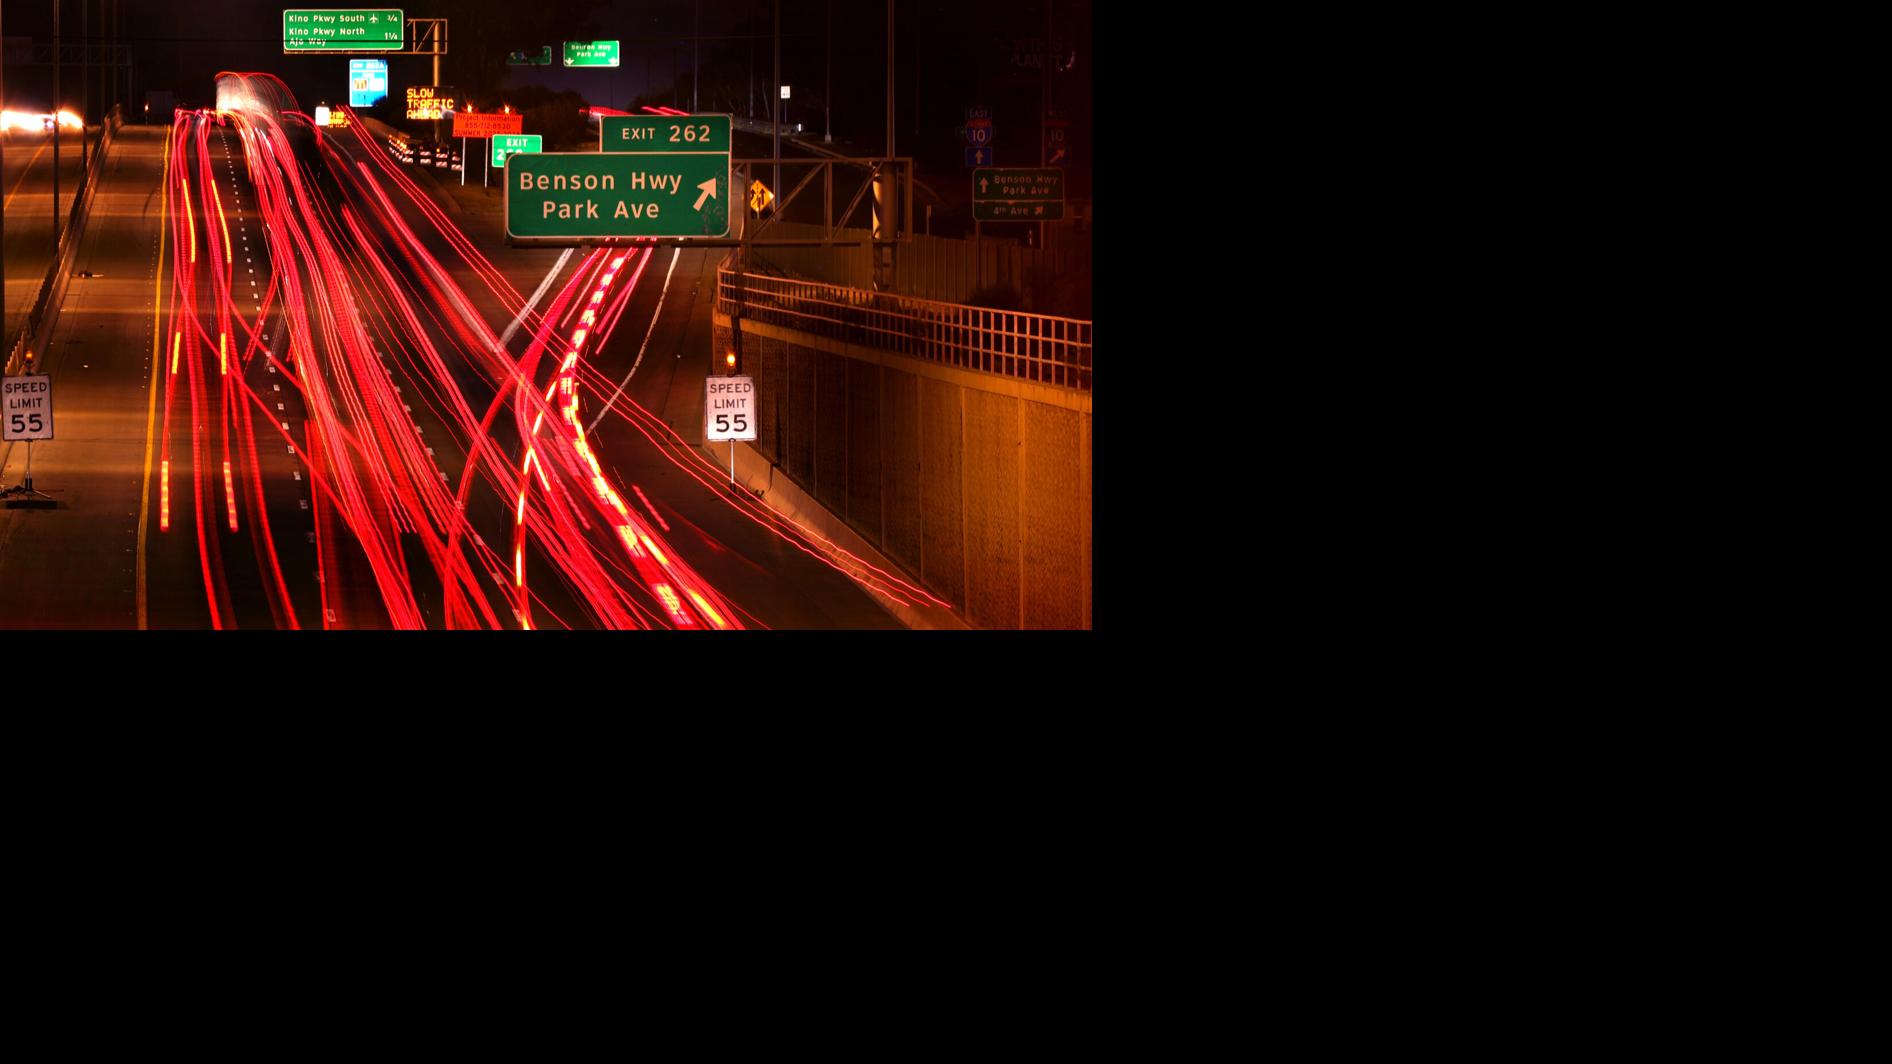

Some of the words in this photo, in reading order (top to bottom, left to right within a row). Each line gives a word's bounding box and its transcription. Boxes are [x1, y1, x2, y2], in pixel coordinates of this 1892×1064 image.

[313, 15, 335, 23] Pkwy
[313, 28, 335, 36] Pkwy
[289, 38, 304, 46] Ajo
[308, 38, 326, 46] Way
[407, 88, 434, 98] SLOW
[407, 99, 454, 109] TRAFFIC
[407, 109, 441, 119] AHEAD
[622, 127, 656, 140] EXIT
[669, 125, 710, 142] 262
[972, 129, 986, 142] 10
[1051, 129, 1064, 142] 10
[506, 138, 528, 147] EXIT
[520, 172, 615, 190] Benson
[631, 172, 682, 194] Hwy
[994, 175, 1032, 184] Benson
[1036, 175, 1058, 184] Hwy
[1002, 185, 1026, 195] Park
[1031, 185, 1049, 194] Ave
[543, 200, 599, 219] Park
[614, 201, 660, 219] Ave
[1010, 207, 1029, 215] Ave
[5, 382, 47, 393] SPEED
[710, 383, 751, 393] SPEED
[10, 398, 43, 409] LIMIT
[714, 398, 747, 409] LIMIT
[11, 413, 43, 433] 55
[716, 413, 747, 432] 55
